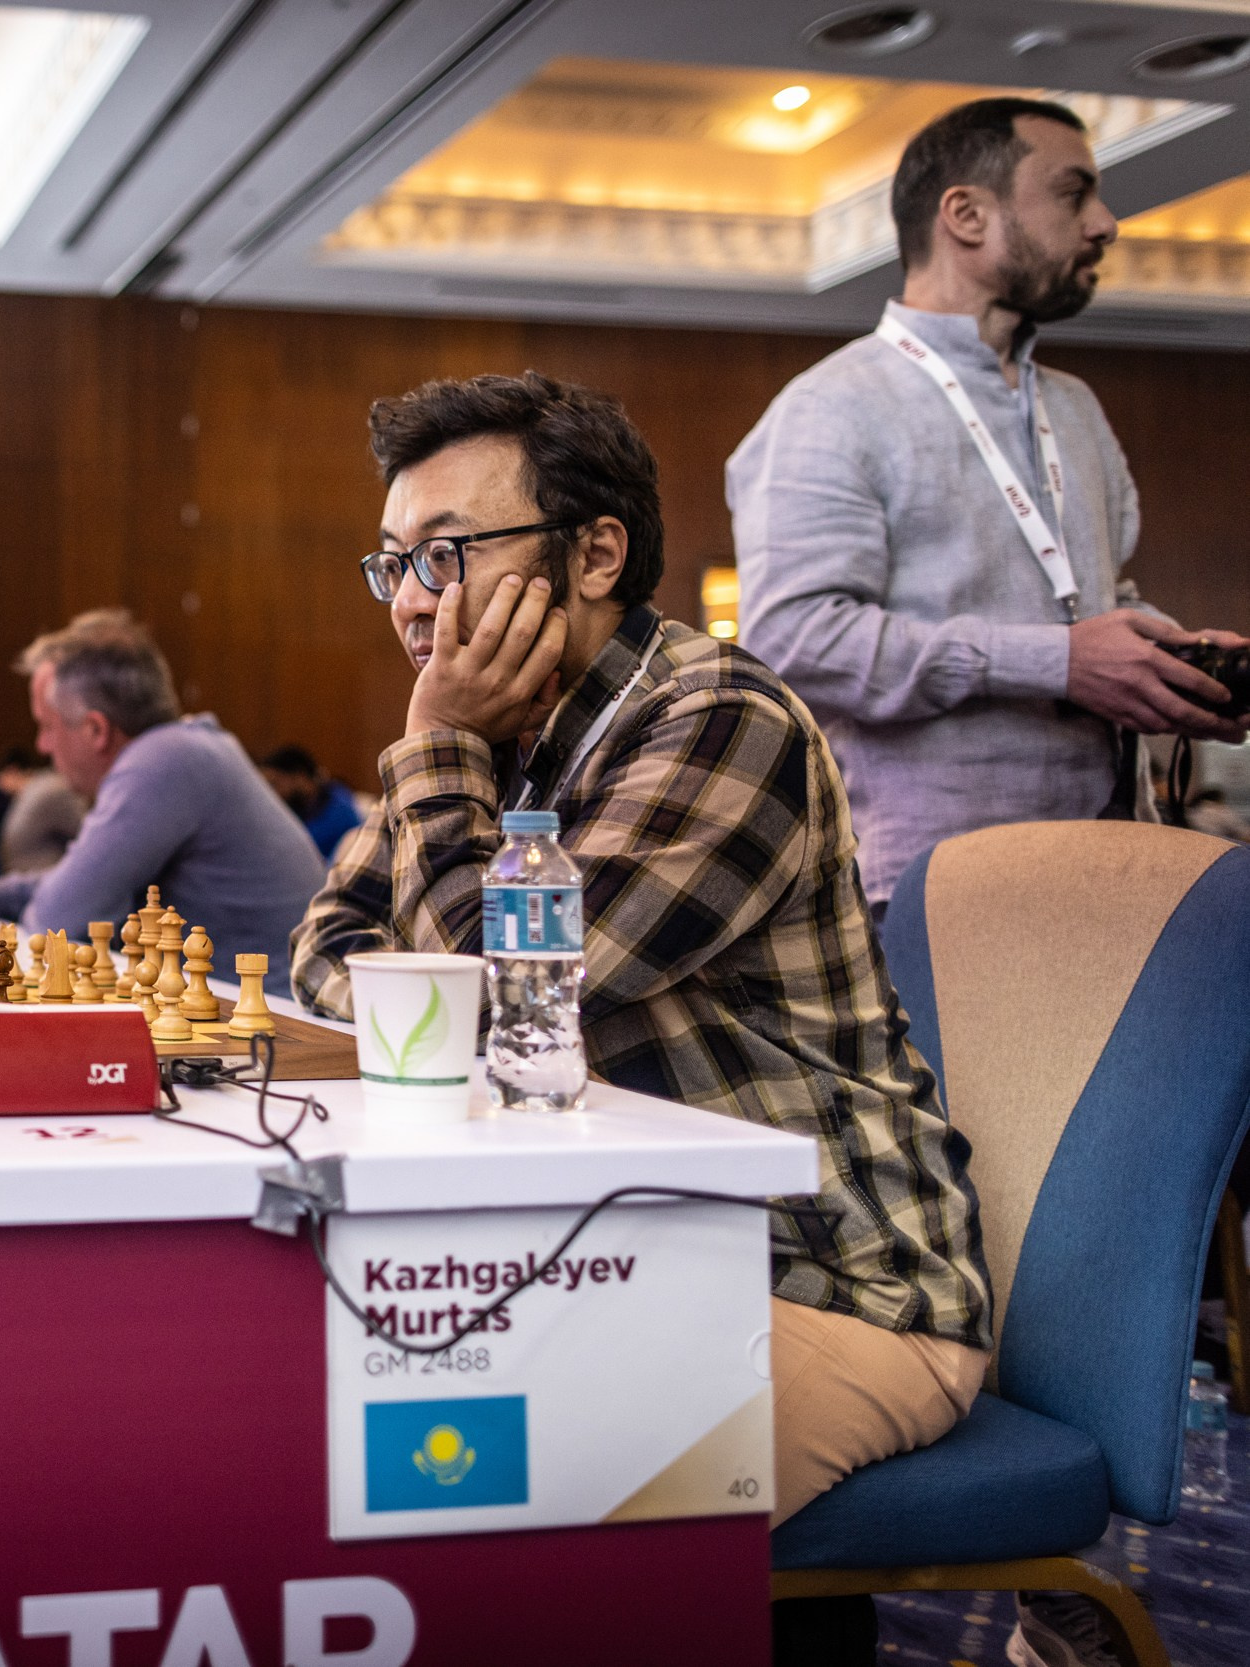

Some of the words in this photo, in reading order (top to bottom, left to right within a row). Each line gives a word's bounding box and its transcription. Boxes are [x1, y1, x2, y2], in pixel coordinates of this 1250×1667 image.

[90, 1063, 128, 1084] DGT
[363, 1251, 636, 1295] Kazhgaleyev
[364, 1301, 512, 1338] Murtas
[363, 1350, 411, 1376] GM
[419, 1347, 491, 1375] 2488
[727, 1477, 760, 1500] 40
